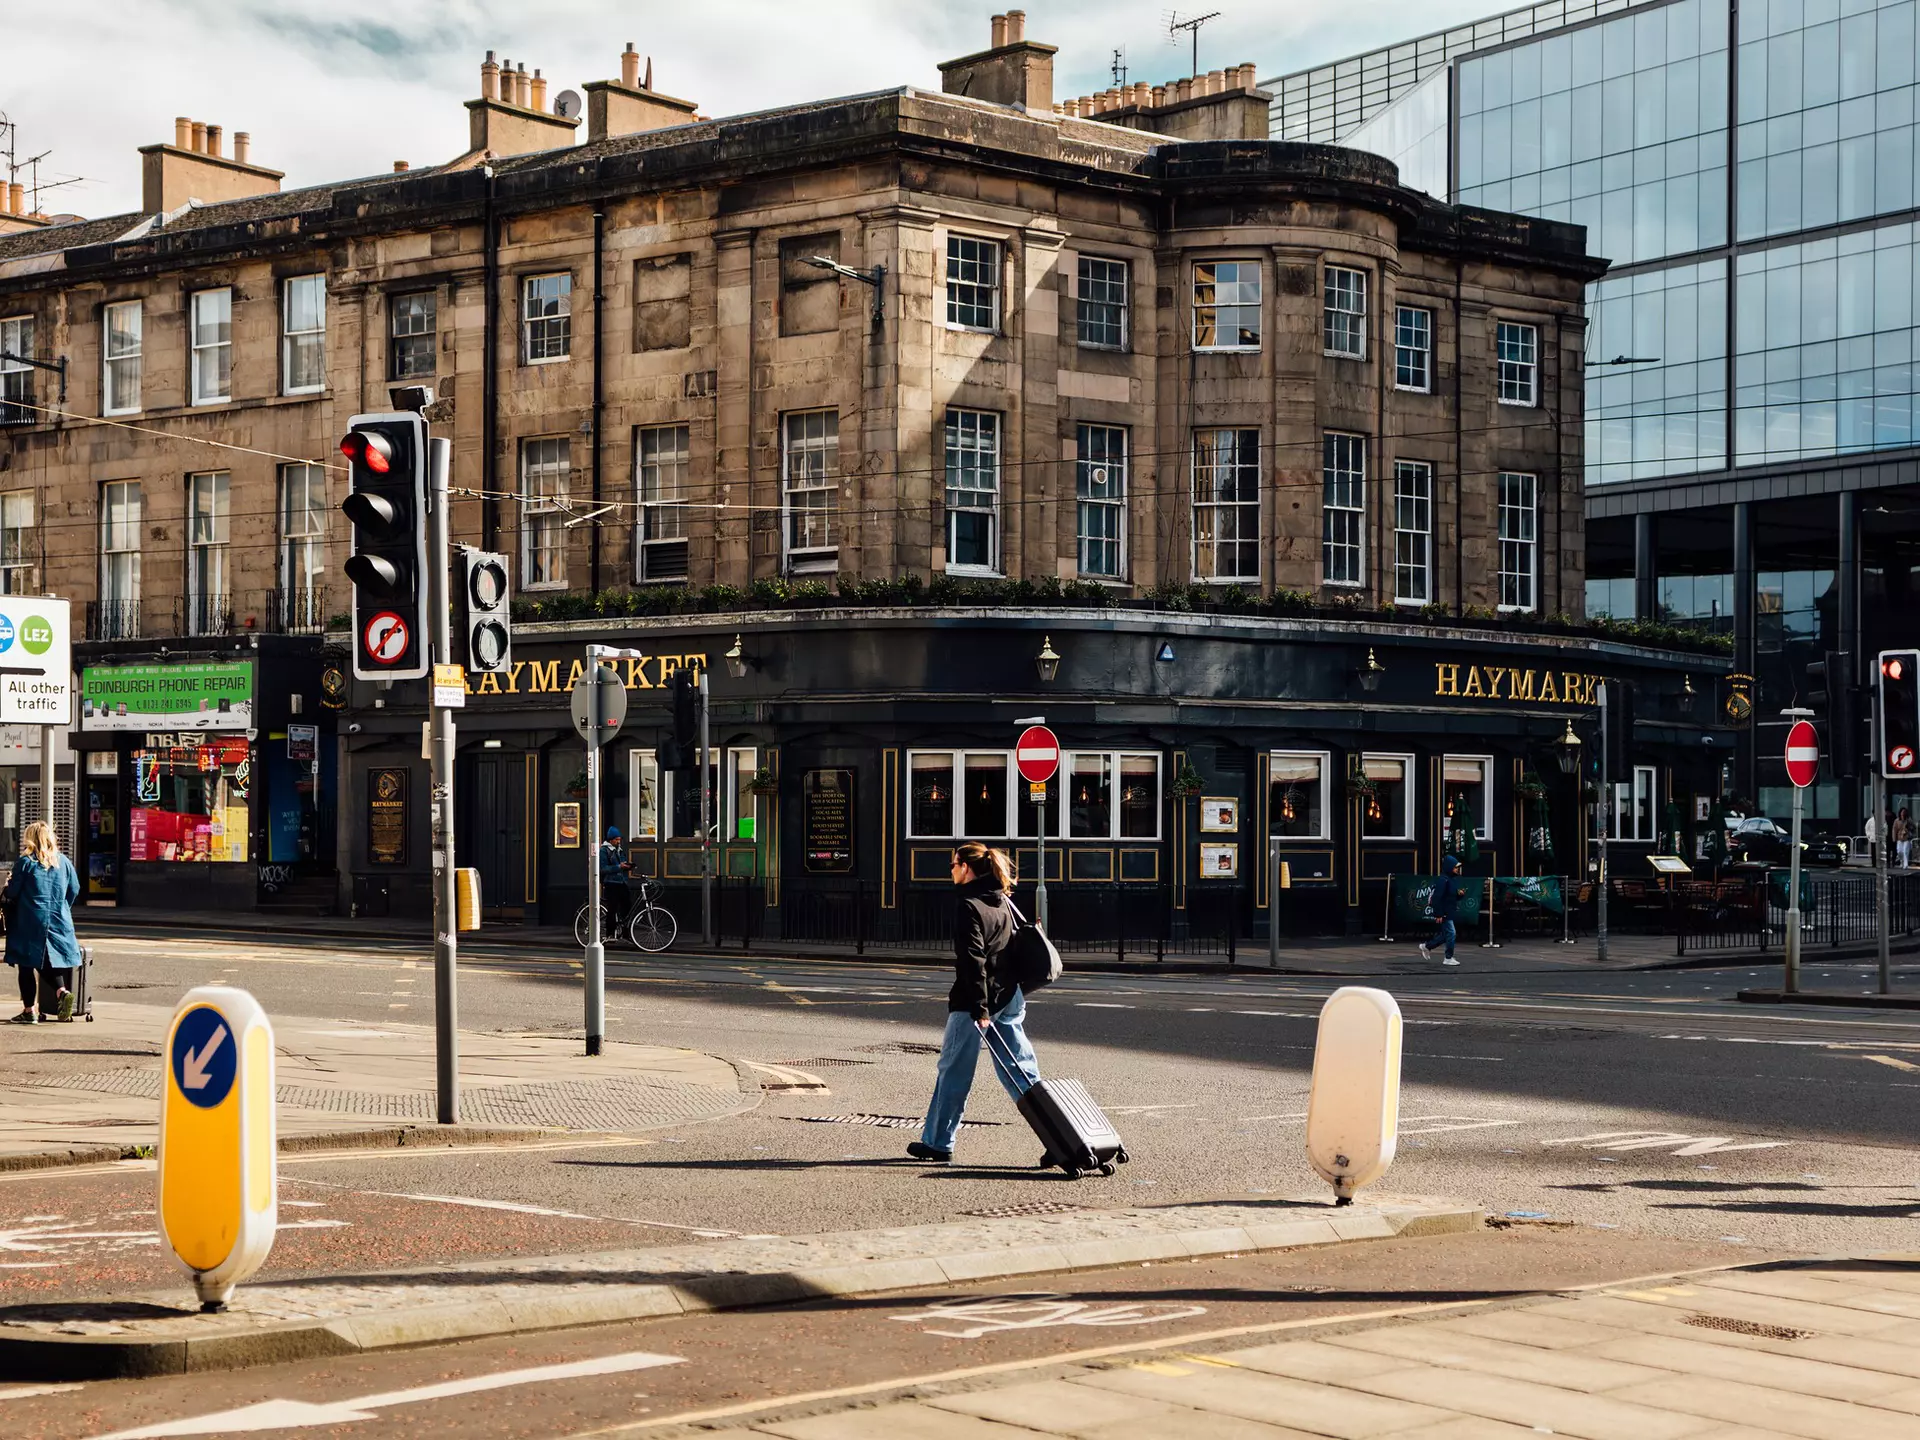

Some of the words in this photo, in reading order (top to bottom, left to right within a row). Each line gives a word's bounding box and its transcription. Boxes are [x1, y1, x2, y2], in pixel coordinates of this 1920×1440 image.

[23, 628, 50, 642] LEZ
[465, 654, 706, 695] AYMAKET
[8, 681, 26, 693] All
[31, 682, 65, 694] other
[88, 679, 155, 694] EDINBURGH
[158, 677, 200, 692] PHONE
[204, 676, 246, 691] REPAIR
[1435, 662, 1606, 705] HAYMARK
[17, 698, 57, 710] traffic
